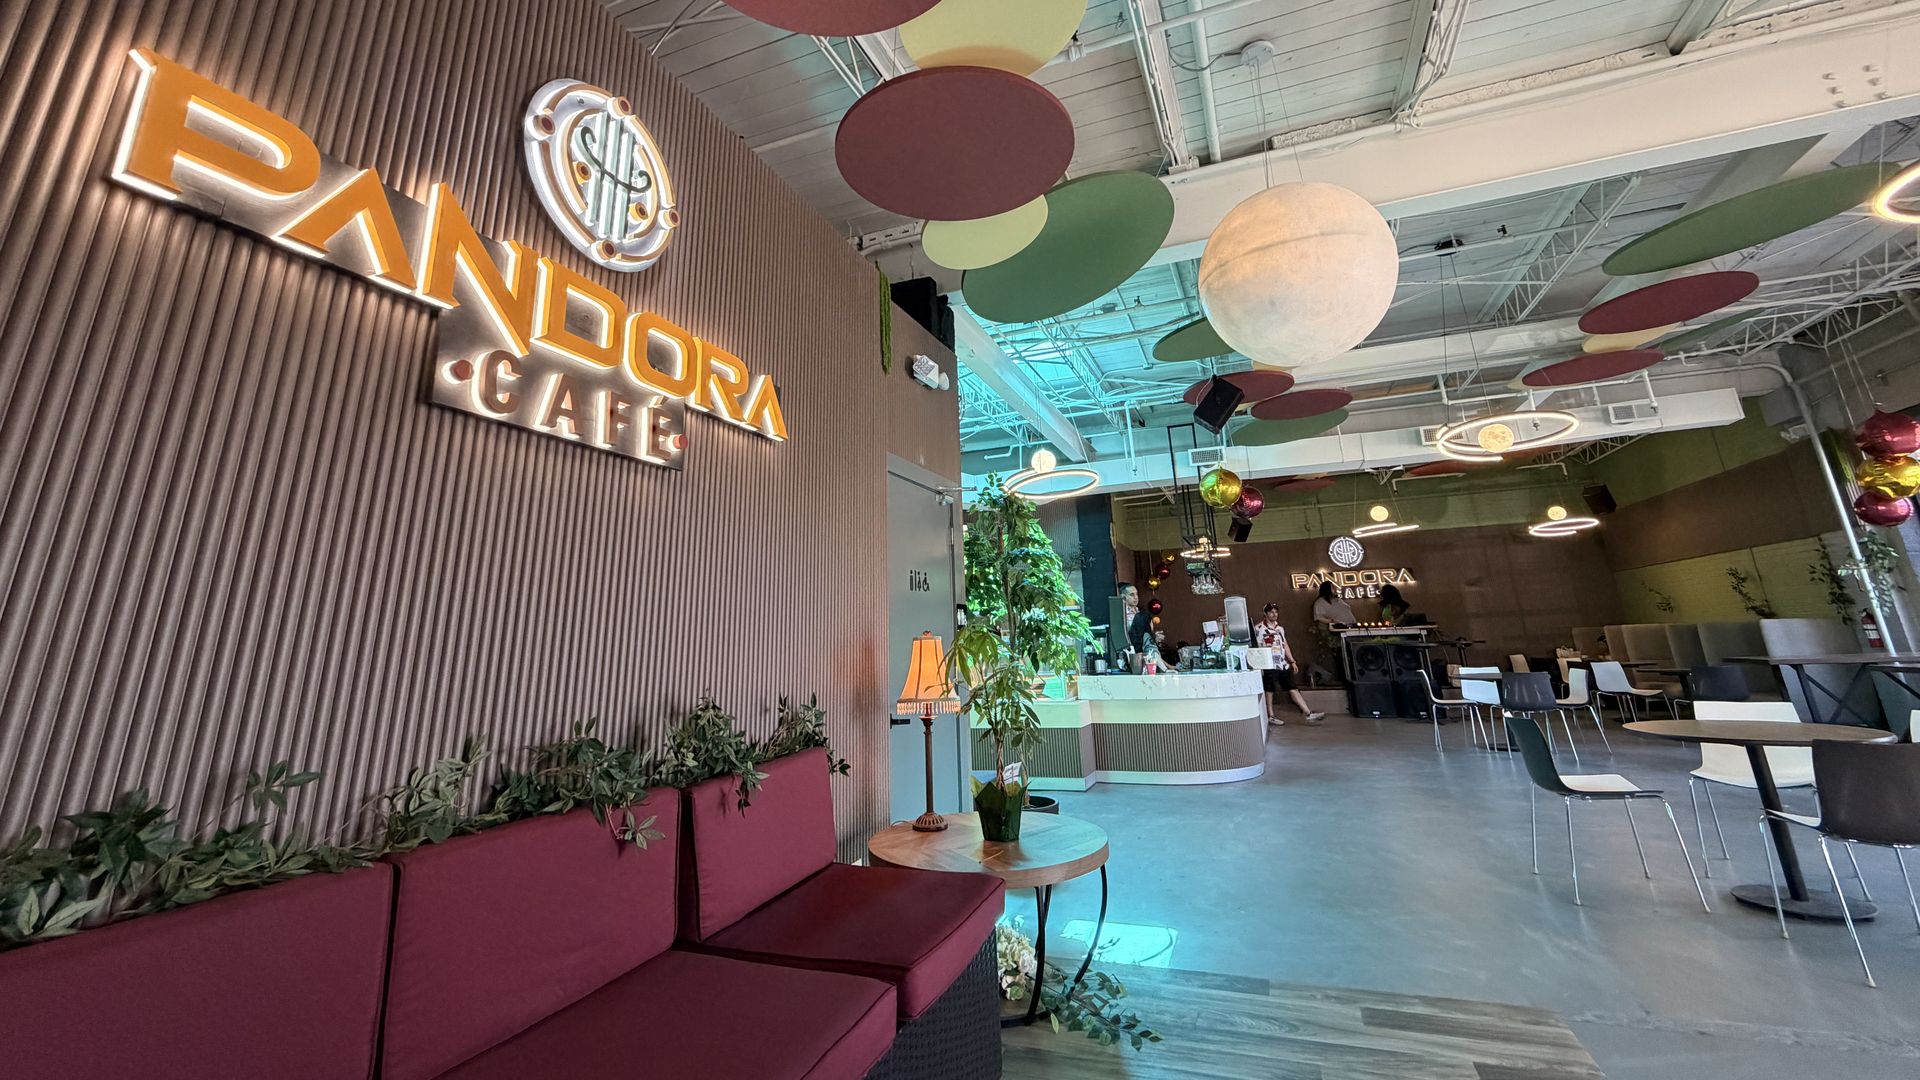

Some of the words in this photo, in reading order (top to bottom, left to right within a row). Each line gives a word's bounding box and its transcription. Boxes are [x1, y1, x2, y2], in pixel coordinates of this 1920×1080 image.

[109, 48, 788, 442] PANDORA
[471, 350, 672, 463] CAFÉ
[1291, 568, 1416, 589] PANDORA
